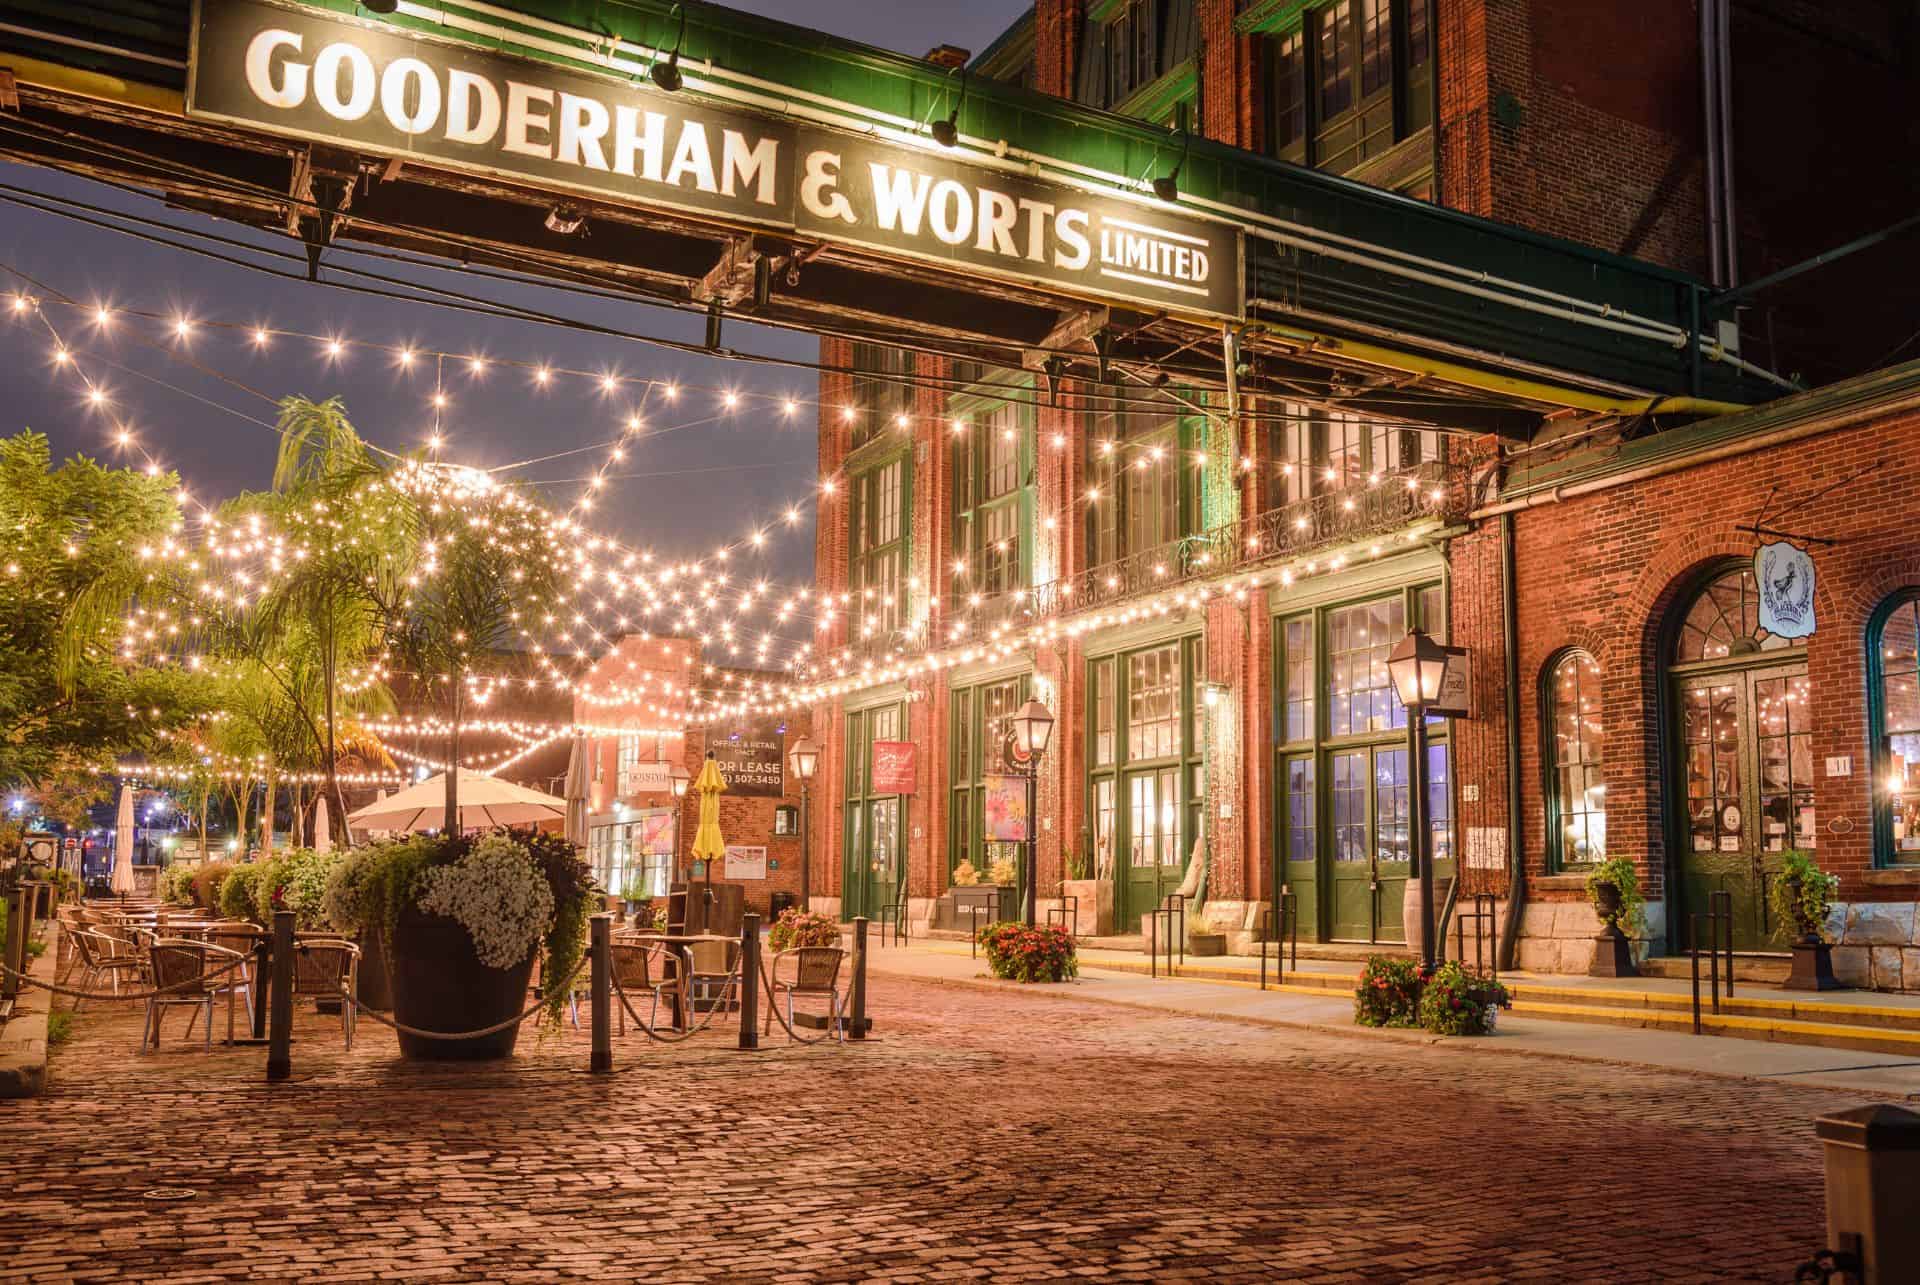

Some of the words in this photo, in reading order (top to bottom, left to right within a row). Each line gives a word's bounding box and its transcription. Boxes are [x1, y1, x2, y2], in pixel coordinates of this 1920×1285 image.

[245, 28, 777, 206] GOODERHAM
[800, 150, 857, 223] &
[868, 160, 1091, 270] WORTS
[1101, 230, 1209, 282] LIMITED
[716, 761, 736, 772] OR
[740, 762, 781, 773] LEASE
[735, 774, 780, 785] 507-3450
